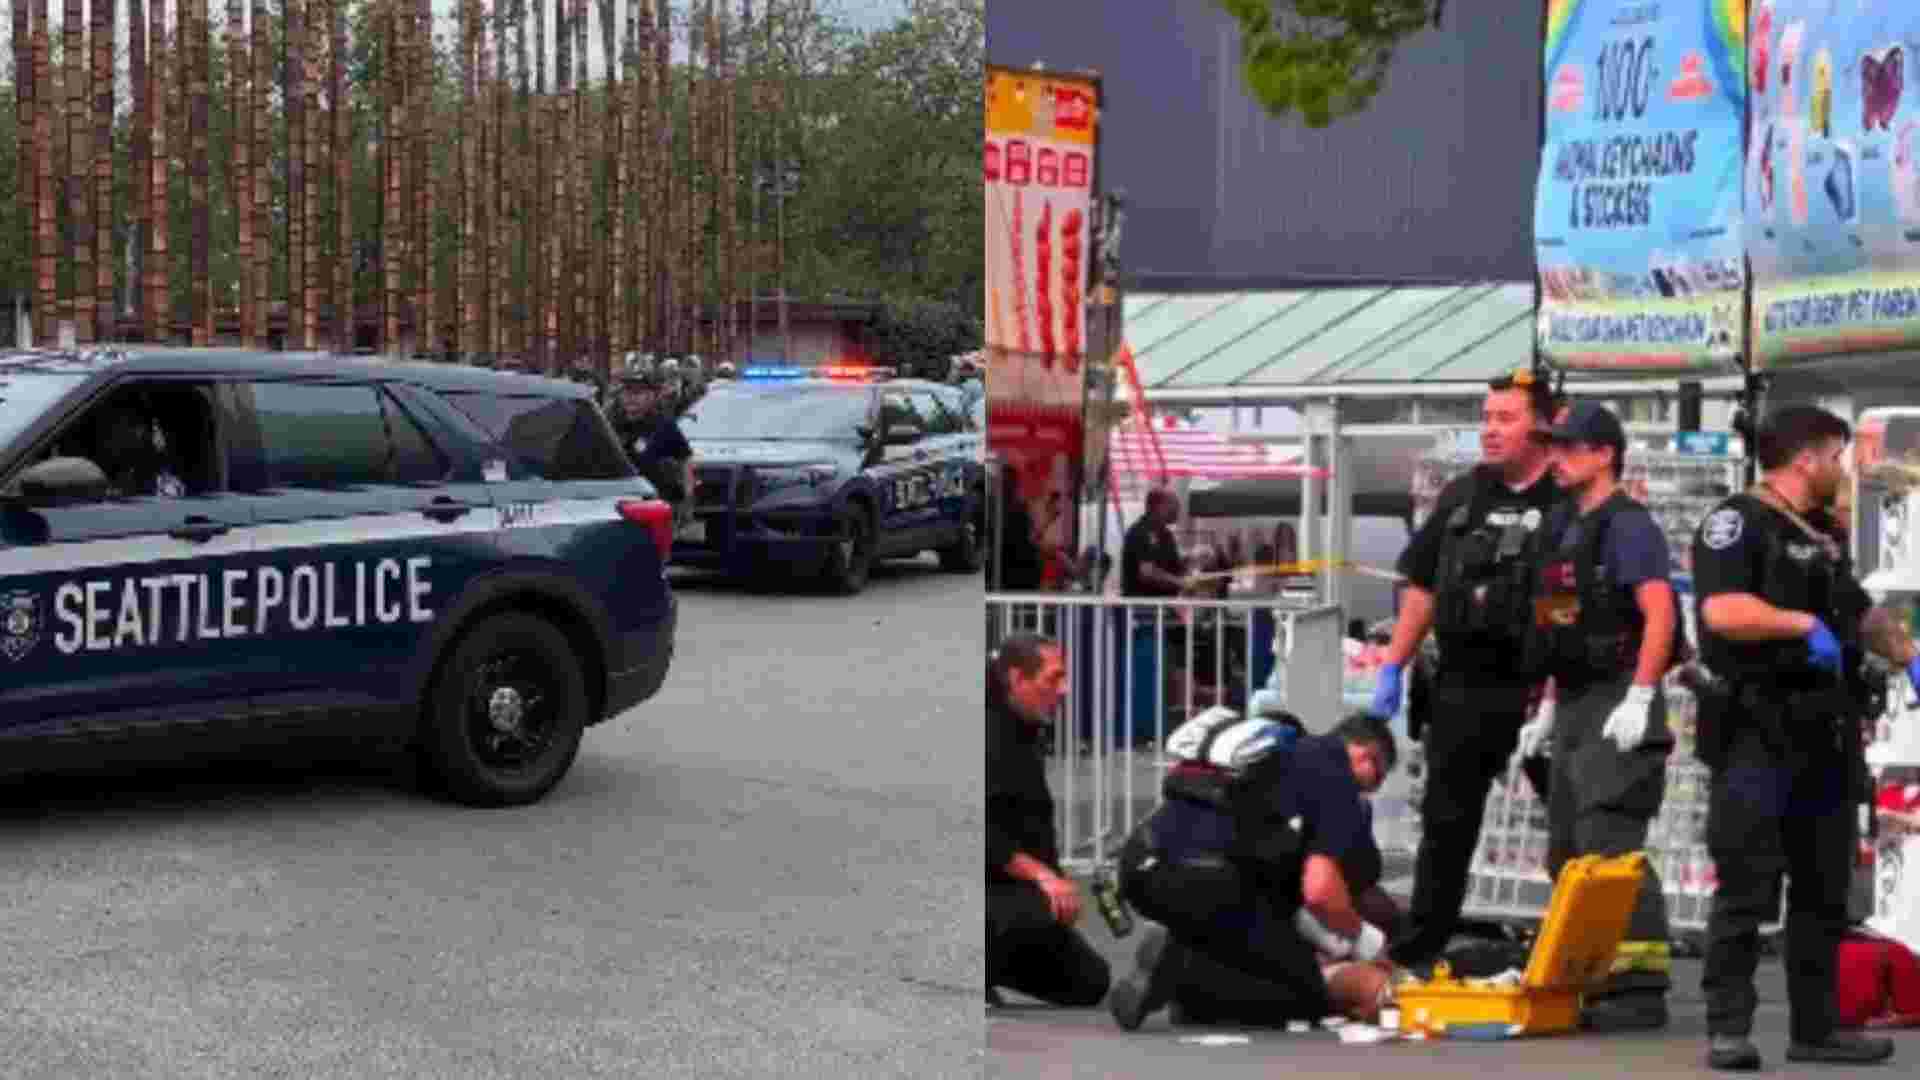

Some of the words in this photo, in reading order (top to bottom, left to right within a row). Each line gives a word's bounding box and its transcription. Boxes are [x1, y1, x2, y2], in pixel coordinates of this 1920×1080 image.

[1584, 180, 1650, 228] STICKERS
[54, 570, 248, 654] SEATTLE
[255, 556, 434, 634] POLICE
